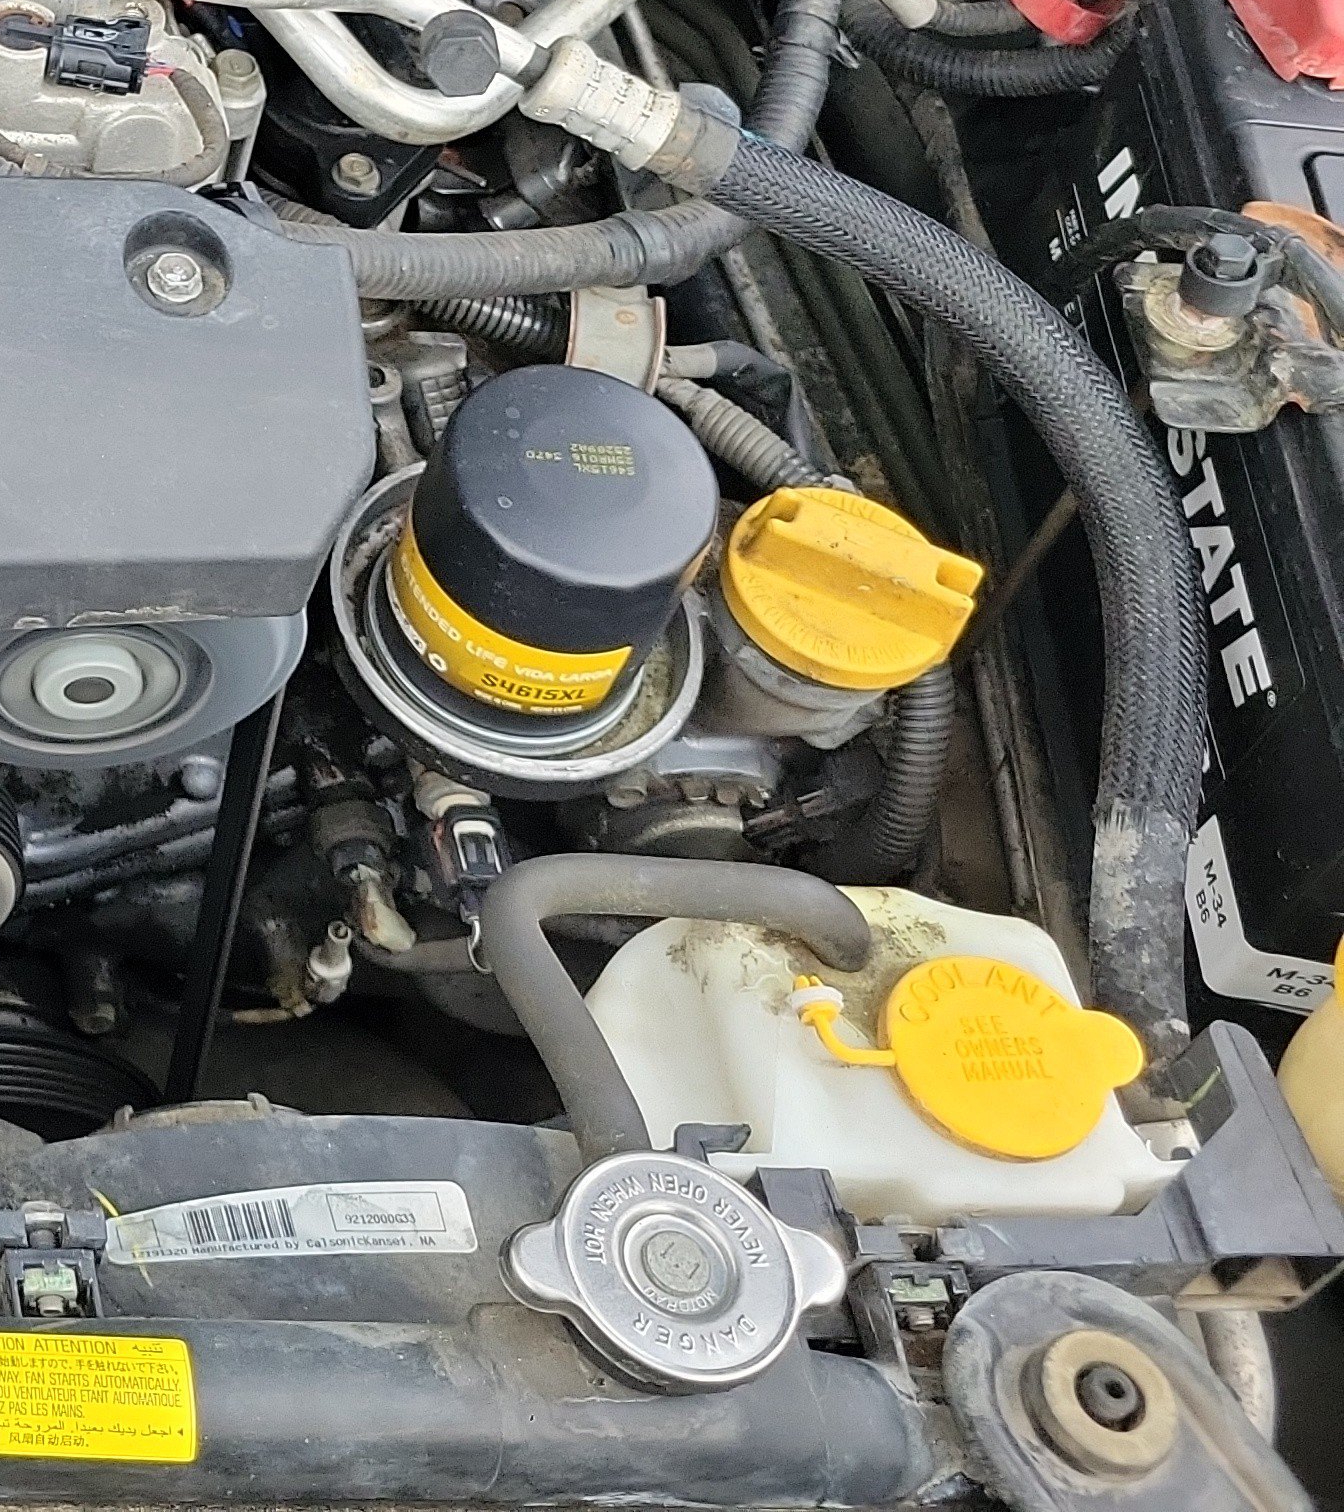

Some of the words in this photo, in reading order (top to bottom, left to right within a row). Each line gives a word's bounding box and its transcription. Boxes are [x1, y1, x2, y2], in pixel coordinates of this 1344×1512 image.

[465, 639, 508, 670] LIFE
[513, 664, 555, 683] VIDA
[480, 672, 588, 702] S4615XL
[1195, 888, 1211, 924] B6
[1203, 858, 1227, 929] M-34
[898, 962, 1068, 1023] COOLANT
[1273, 984, 1313, 998] B6
[959, 1014, 1009, 1035] SEE
[954, 1036, 1044, 1059] OWNERS
[962, 1058, 1055, 1082] MANUAL
[589, 1171, 647, 1223] WHEN
[648, 1171, 709, 1204] OPEN
[192, 1240, 280, 1256] Manufactured
[285, 1238, 300, 1251] by
[419, 1236, 437, 1247] NA
[583, 1222, 608, 1266] HOT
[712, 1197, 770, 1268] NEVER
[33, 1337, 117, 1355] ATTENTION
[632, 1311, 759, 1356] DANGER
[13, 1385, 77, 1402] VENTILATEUR
[112, 1390, 183, 1408] AUTOMATIQUE
[25, 1371, 45, 1386] FAN
[49, 1372, 90, 1388] STARTS
[93, 1374, 182, 1393] AUTOMATICALLY.
[8, 1401, 27, 1416] PAS
[30, 1402, 49, 1417] LES
[52, 1403, 85, 1419] MAINS.
